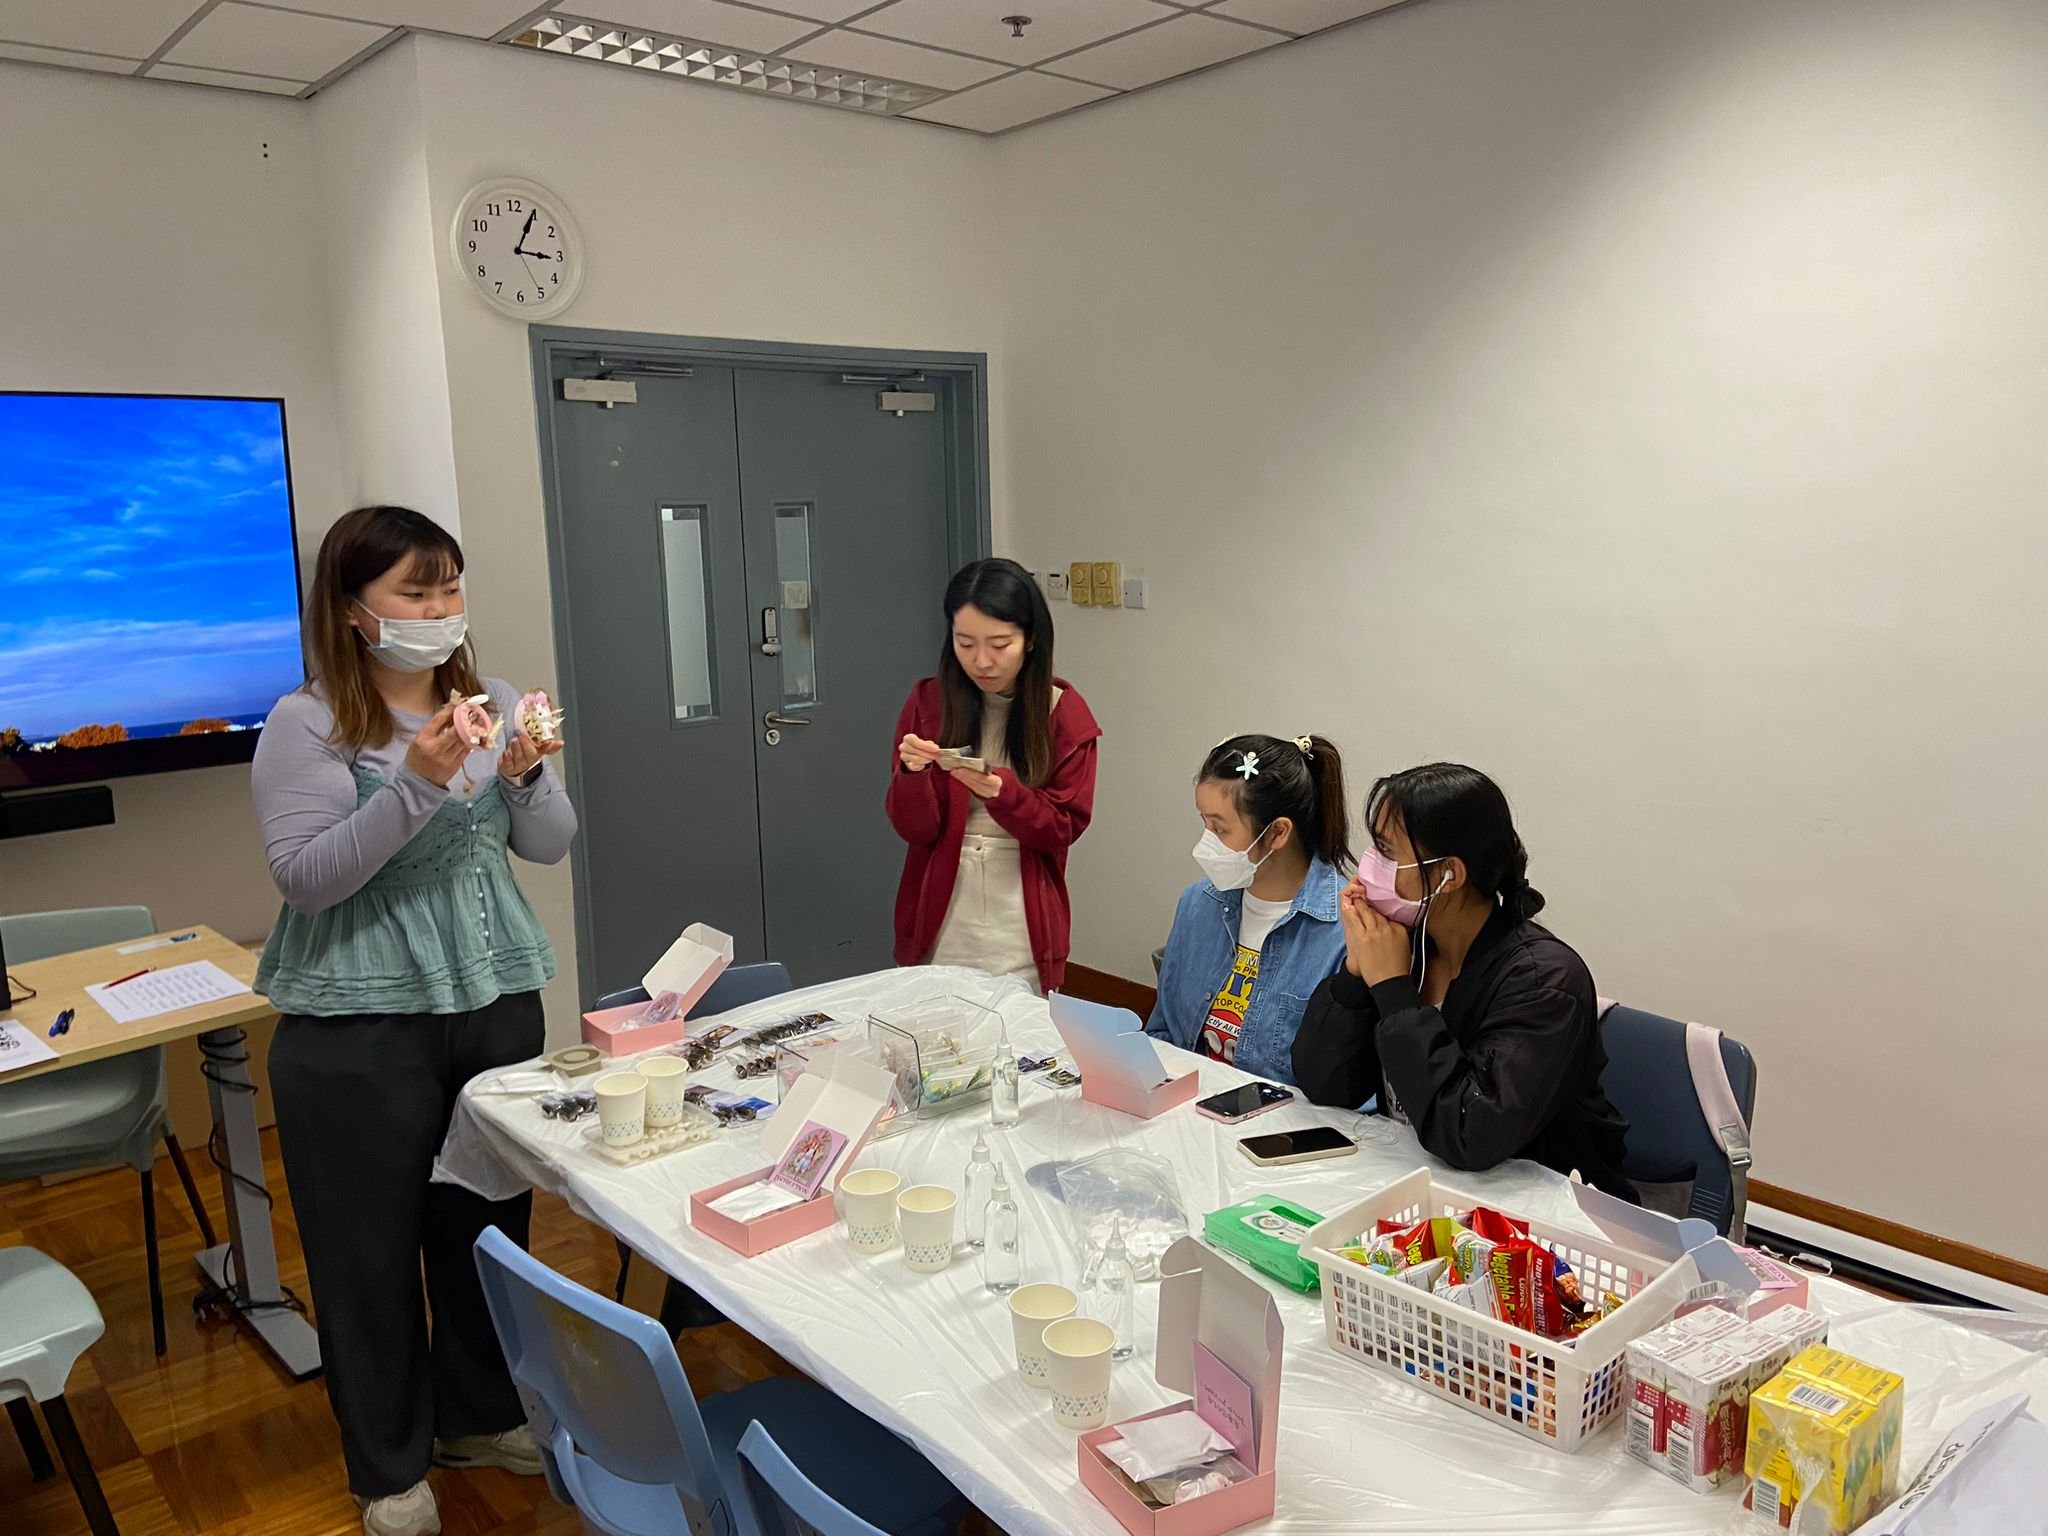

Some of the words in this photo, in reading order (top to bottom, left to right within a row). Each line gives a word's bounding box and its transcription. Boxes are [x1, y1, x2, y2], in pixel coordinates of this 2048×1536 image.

[486, 203, 502, 217] 11
[506, 199, 522, 213] 12
[472, 219, 488, 233] 10
[547, 225, 555, 238] 2
[468, 240, 477, 253] 9
[556, 250, 564, 263] 3
[478, 264, 486, 277] 8
[551, 272, 558, 284] 4
[494, 281, 503, 294] 7
[538, 287, 545, 299] 5
[516, 290, 524, 303] 6
[1207, 1017, 1222, 1028] ctly
